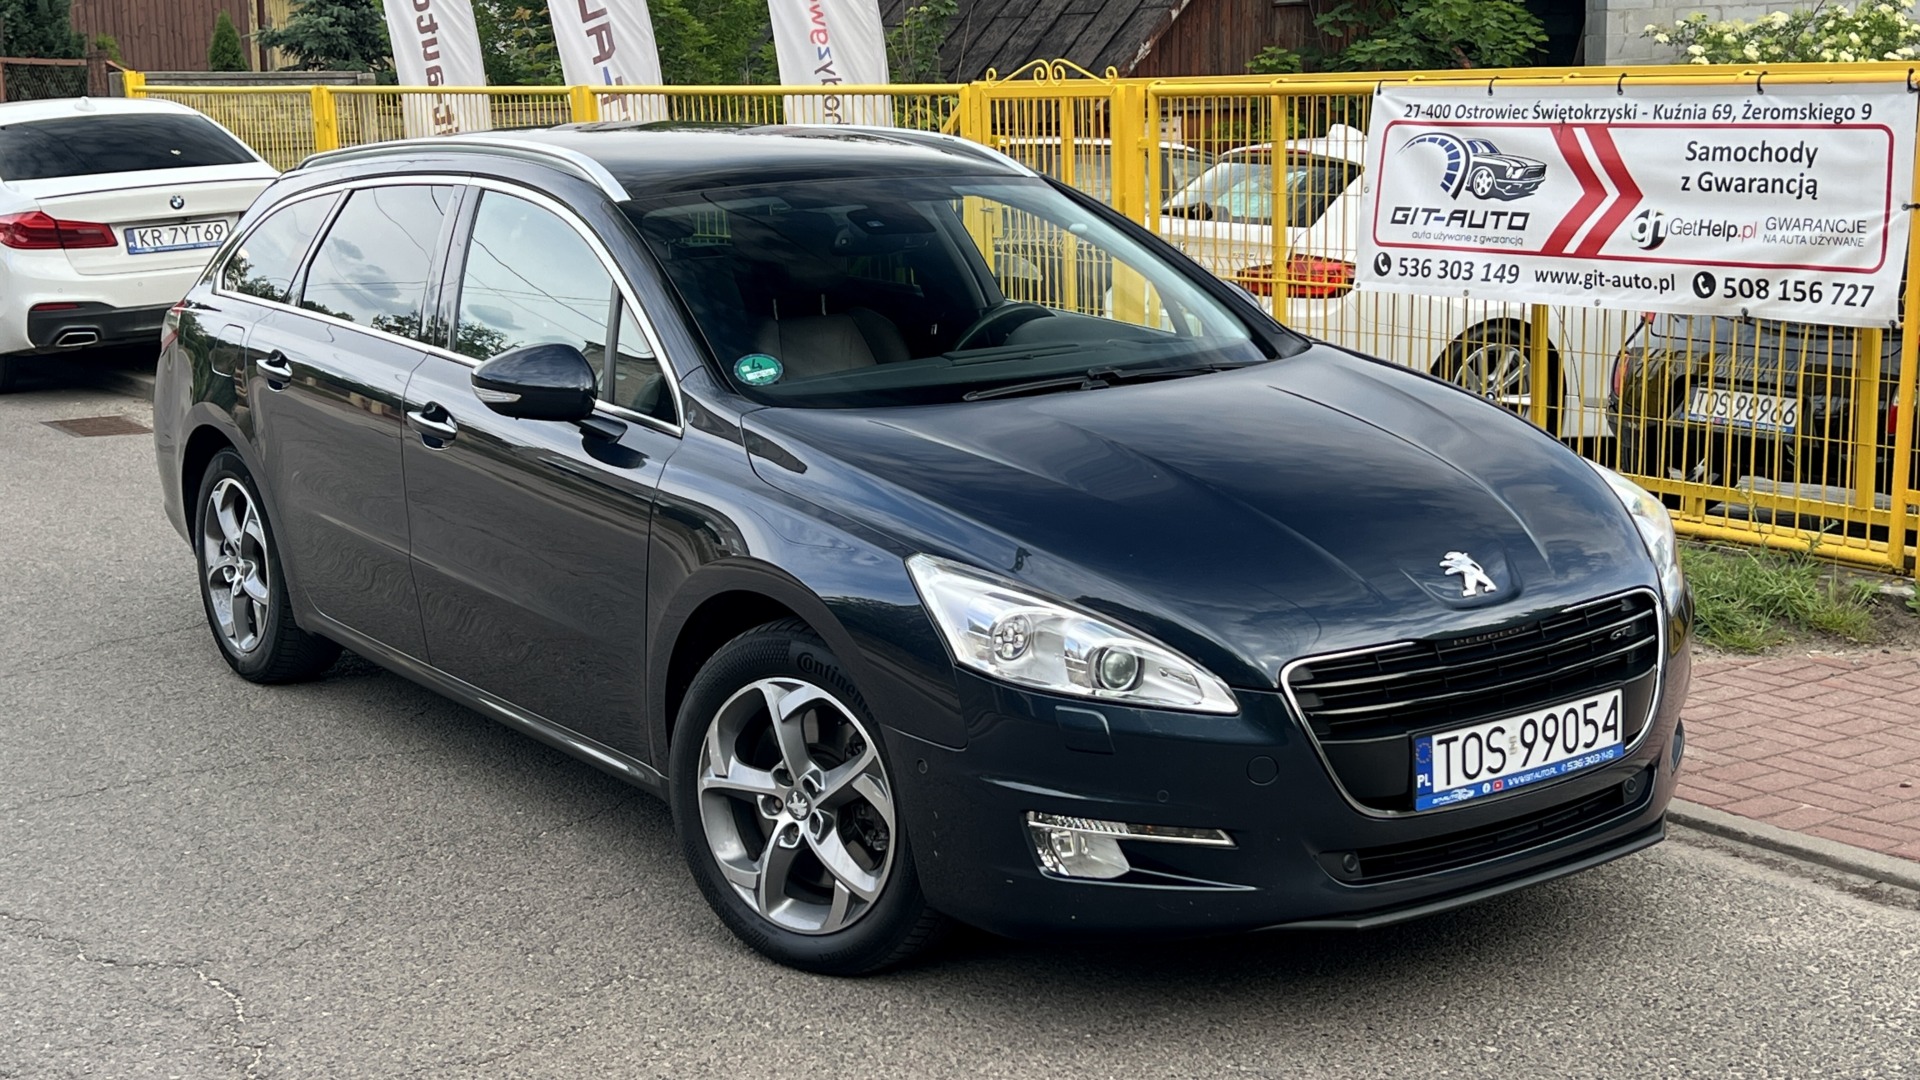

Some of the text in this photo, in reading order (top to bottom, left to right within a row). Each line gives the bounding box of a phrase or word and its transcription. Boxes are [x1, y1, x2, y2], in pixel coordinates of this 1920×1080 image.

[1403, 103, 1452, 119] 27-400
[1454, 103, 1530, 120] Ostrowiec
[1532, 100, 1638, 125] Świętokrzyski
[1652, 102, 1707, 121] Kuźnia
[1711, 103, 1736, 122] 69,
[1741, 100, 1856, 125] Żeromskiego
[1860, 103, 1873, 121] 9
[1684, 140, 1819, 168] Samochody
[1680, 171, 1819, 201] z Gwarancją
[1390, 206, 1531, 231] GIT-AUTO
[1669, 216, 1757, 242] GetHelp.pl
[1765, 216, 1867, 235] GWARANCJE
[138, 228, 163, 248] KR
[169, 223, 223, 244] 7YT69
[1411, 230, 1432, 240] auta
[1433, 231, 1472, 243] używane
[1479, 235, 1524, 246] gwarancją
[1762, 233, 1865, 248] NA AUTA UŻYWANE
[1398, 257, 1520, 284] 536 303 149
[1534, 269, 1675, 294] www.git-auto.pl
[1723, 277, 1875, 308] 508 156 727
[751, 358, 763, 370] 4
[1697, 390, 1731, 417] TOS
[1453, 625, 1527, 646] PEUGEOT
[1610, 624, 1632, 640] GT
[1436, 695, 1619, 786] TOS 99054
[1416, 774, 1432, 789] PL
